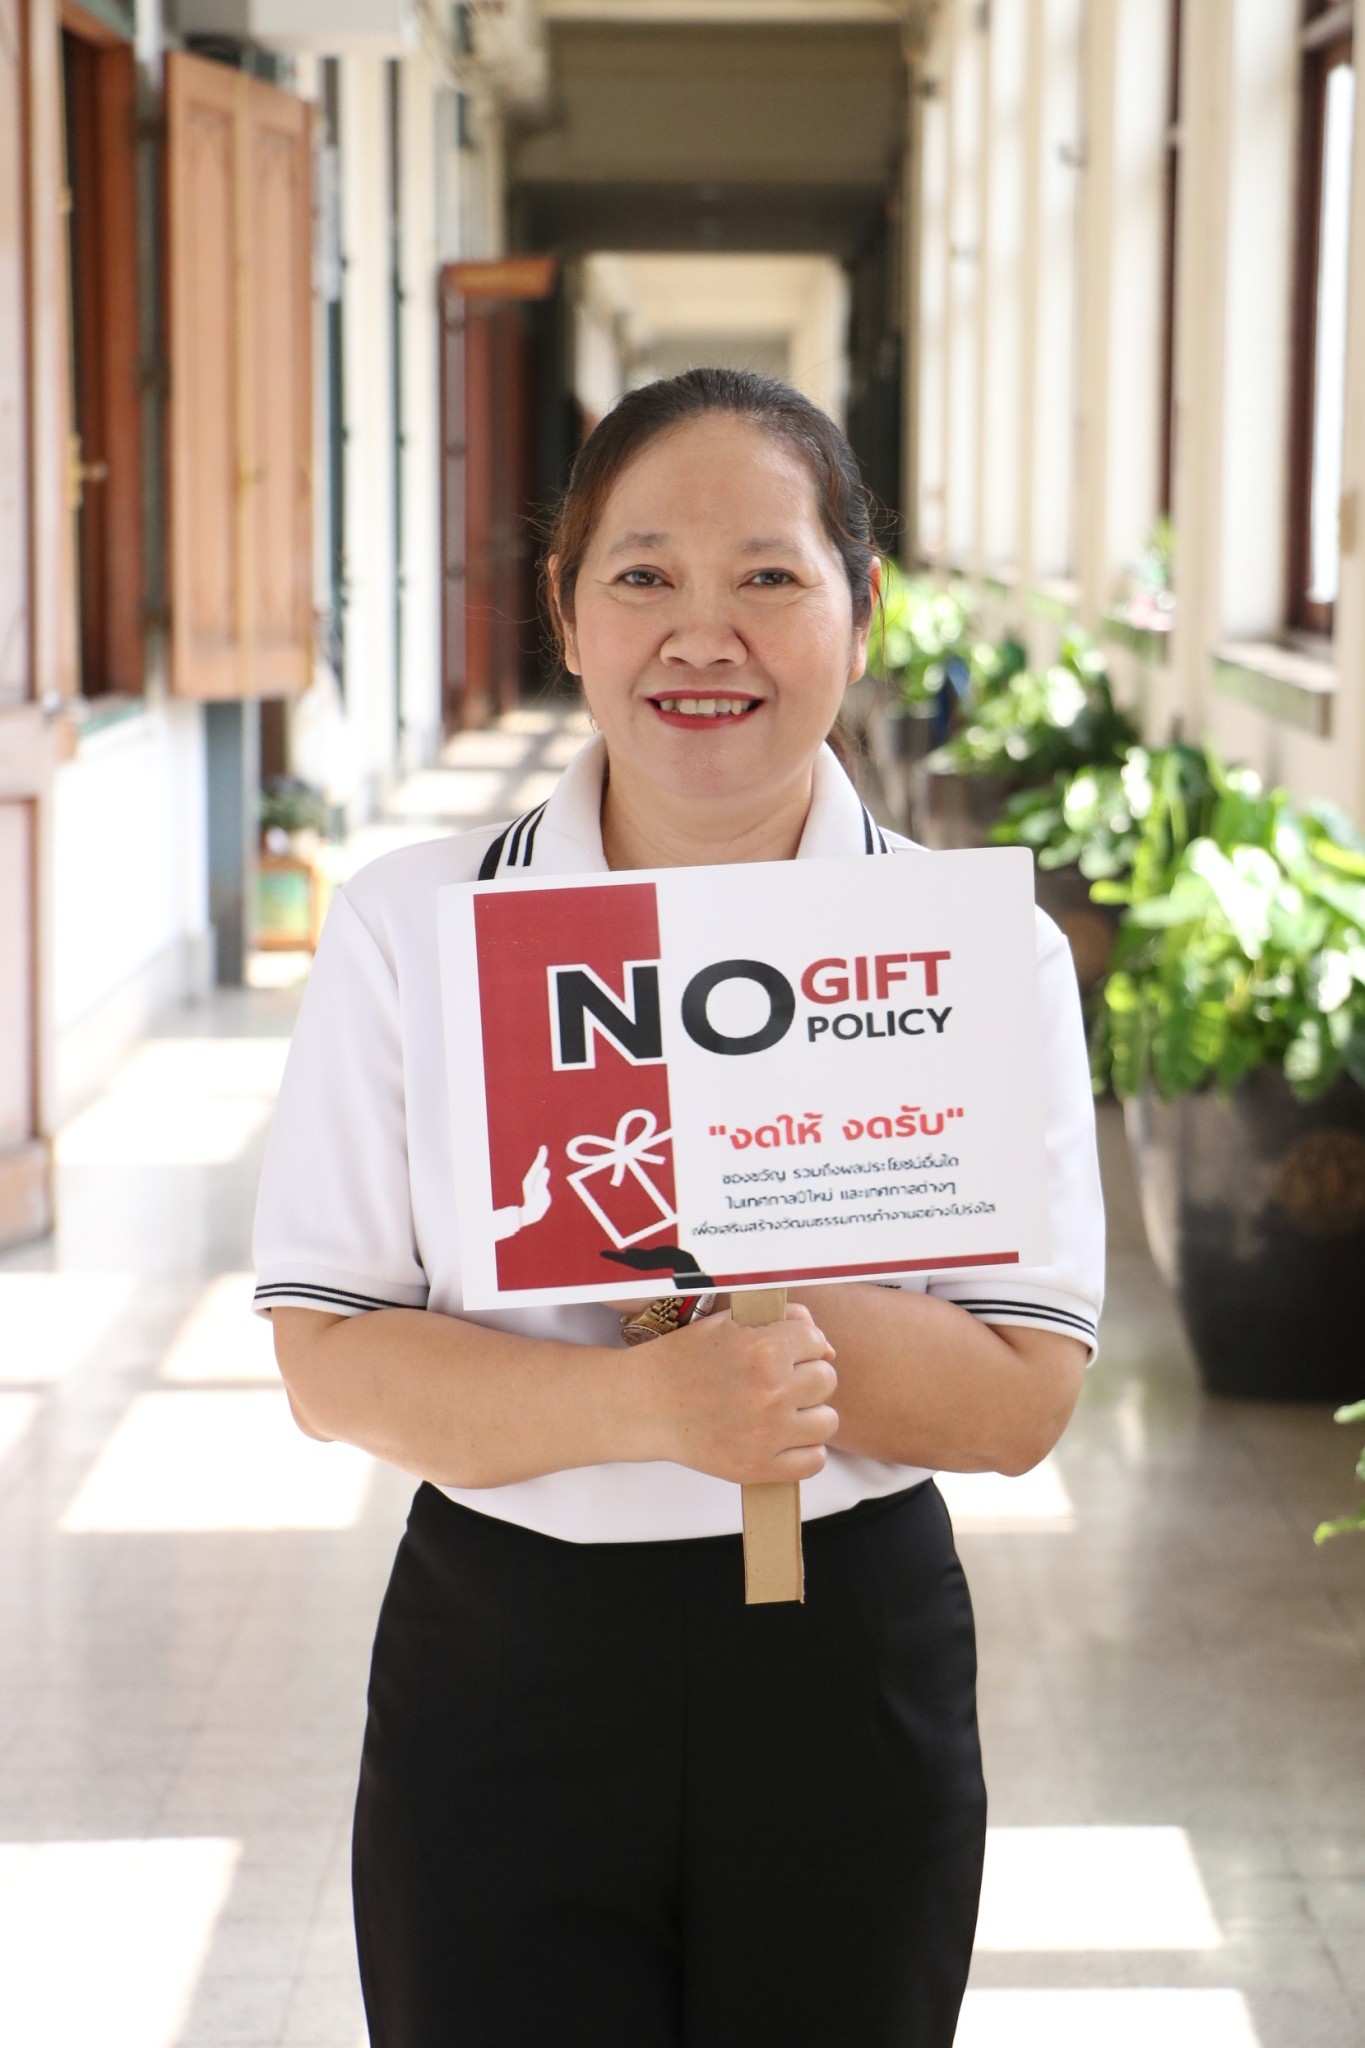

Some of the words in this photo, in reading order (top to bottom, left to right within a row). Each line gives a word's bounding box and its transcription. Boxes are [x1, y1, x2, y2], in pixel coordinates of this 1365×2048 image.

[553, 957, 796, 1066] NO
[800, 950, 952, 1005] GIFT
[806, 1006, 953, 1042] POLICY
[708, 1112, 823, 1150] "งดให้
[842, 1104, 964, 1141] งดรับ"
[721, 1168, 786, 1185] ของขวัญ
